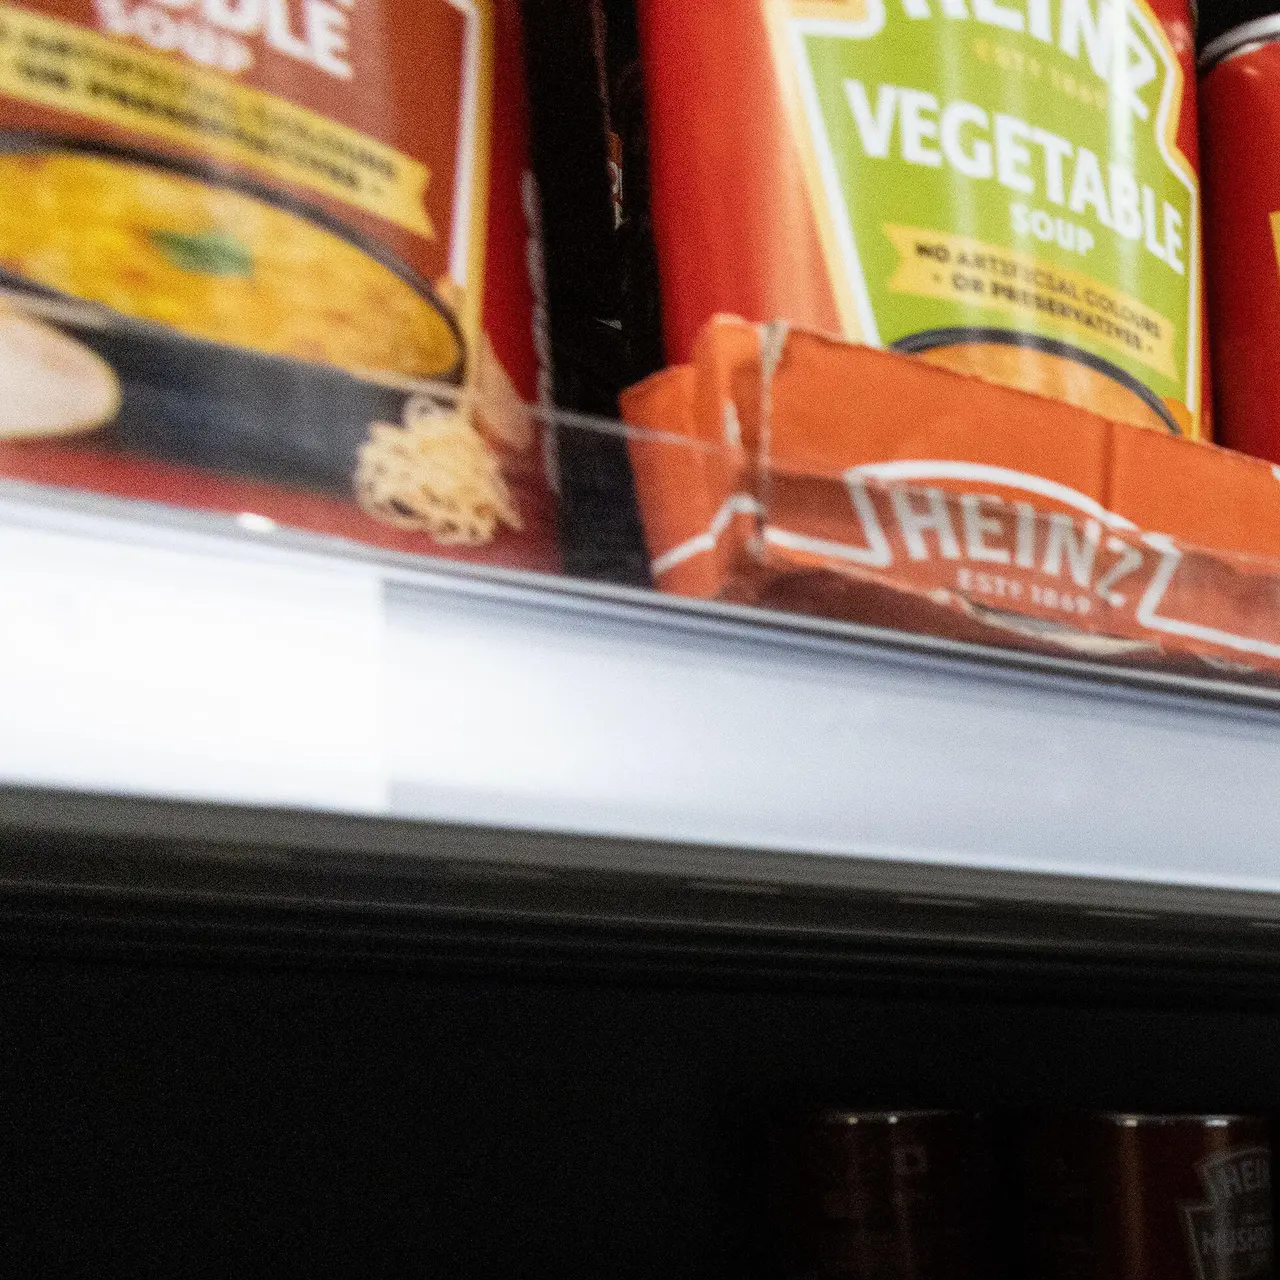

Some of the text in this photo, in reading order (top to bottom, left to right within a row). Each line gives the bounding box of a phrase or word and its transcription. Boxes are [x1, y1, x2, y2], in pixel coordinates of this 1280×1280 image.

[902, 0, 1156, 120] INZ
[845, 78, 1184, 276] VEGETABLE
[1010, 202, 1094, 255] SOUP
[890, 484, 1144, 609] HEINZ
